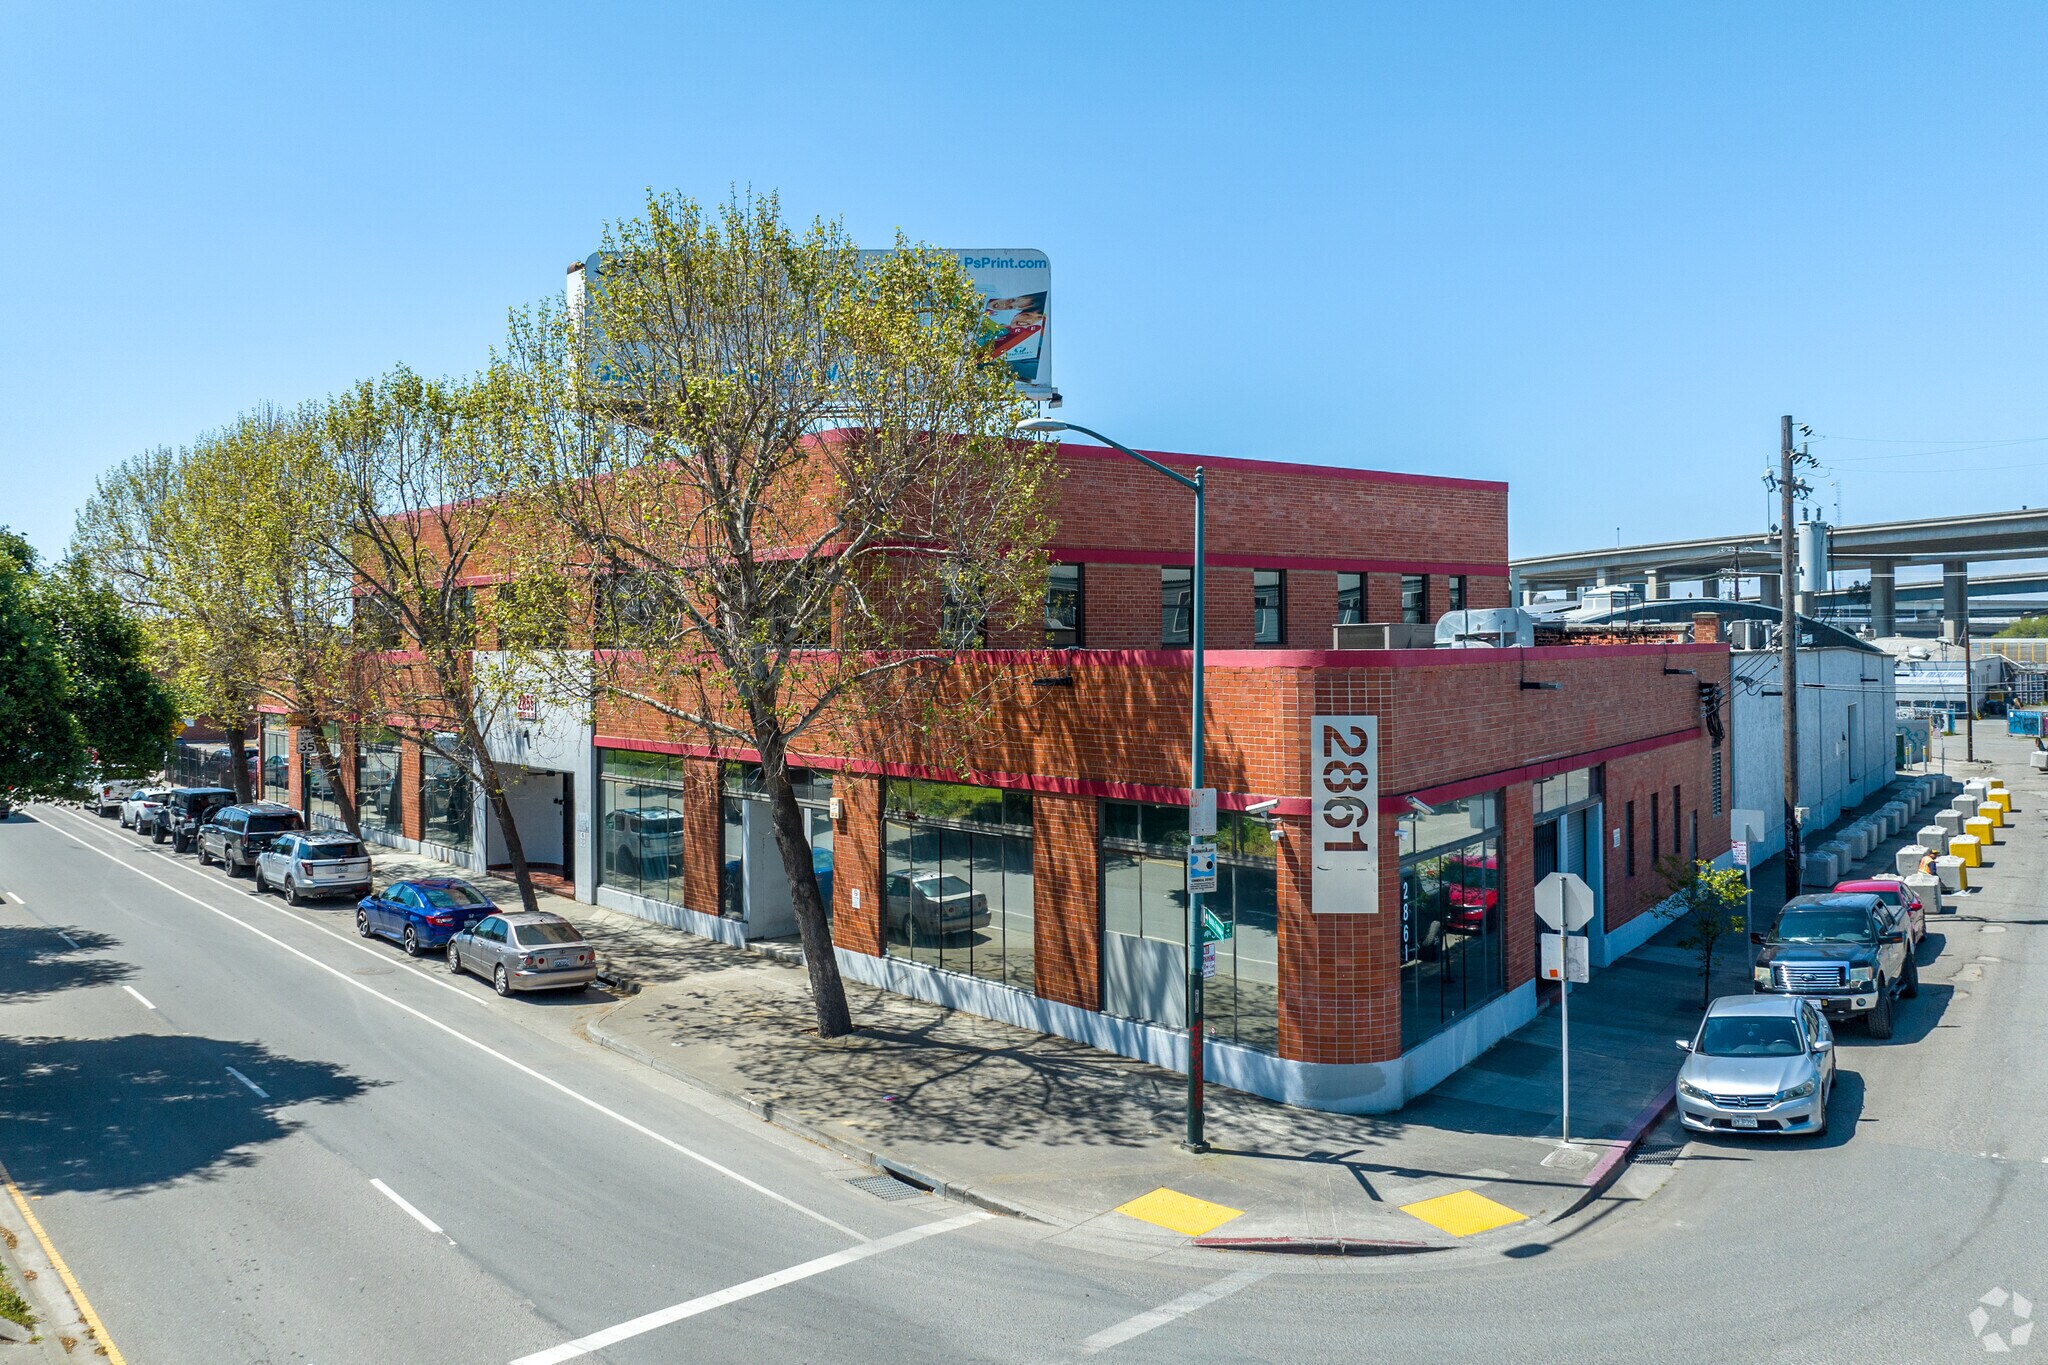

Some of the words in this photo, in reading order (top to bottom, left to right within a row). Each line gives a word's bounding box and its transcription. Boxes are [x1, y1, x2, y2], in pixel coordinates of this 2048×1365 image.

[964, 257, 1047, 269] PsPrint.com
[300, 742, 315, 752] 35
[1323, 725, 1369, 852] 2861
